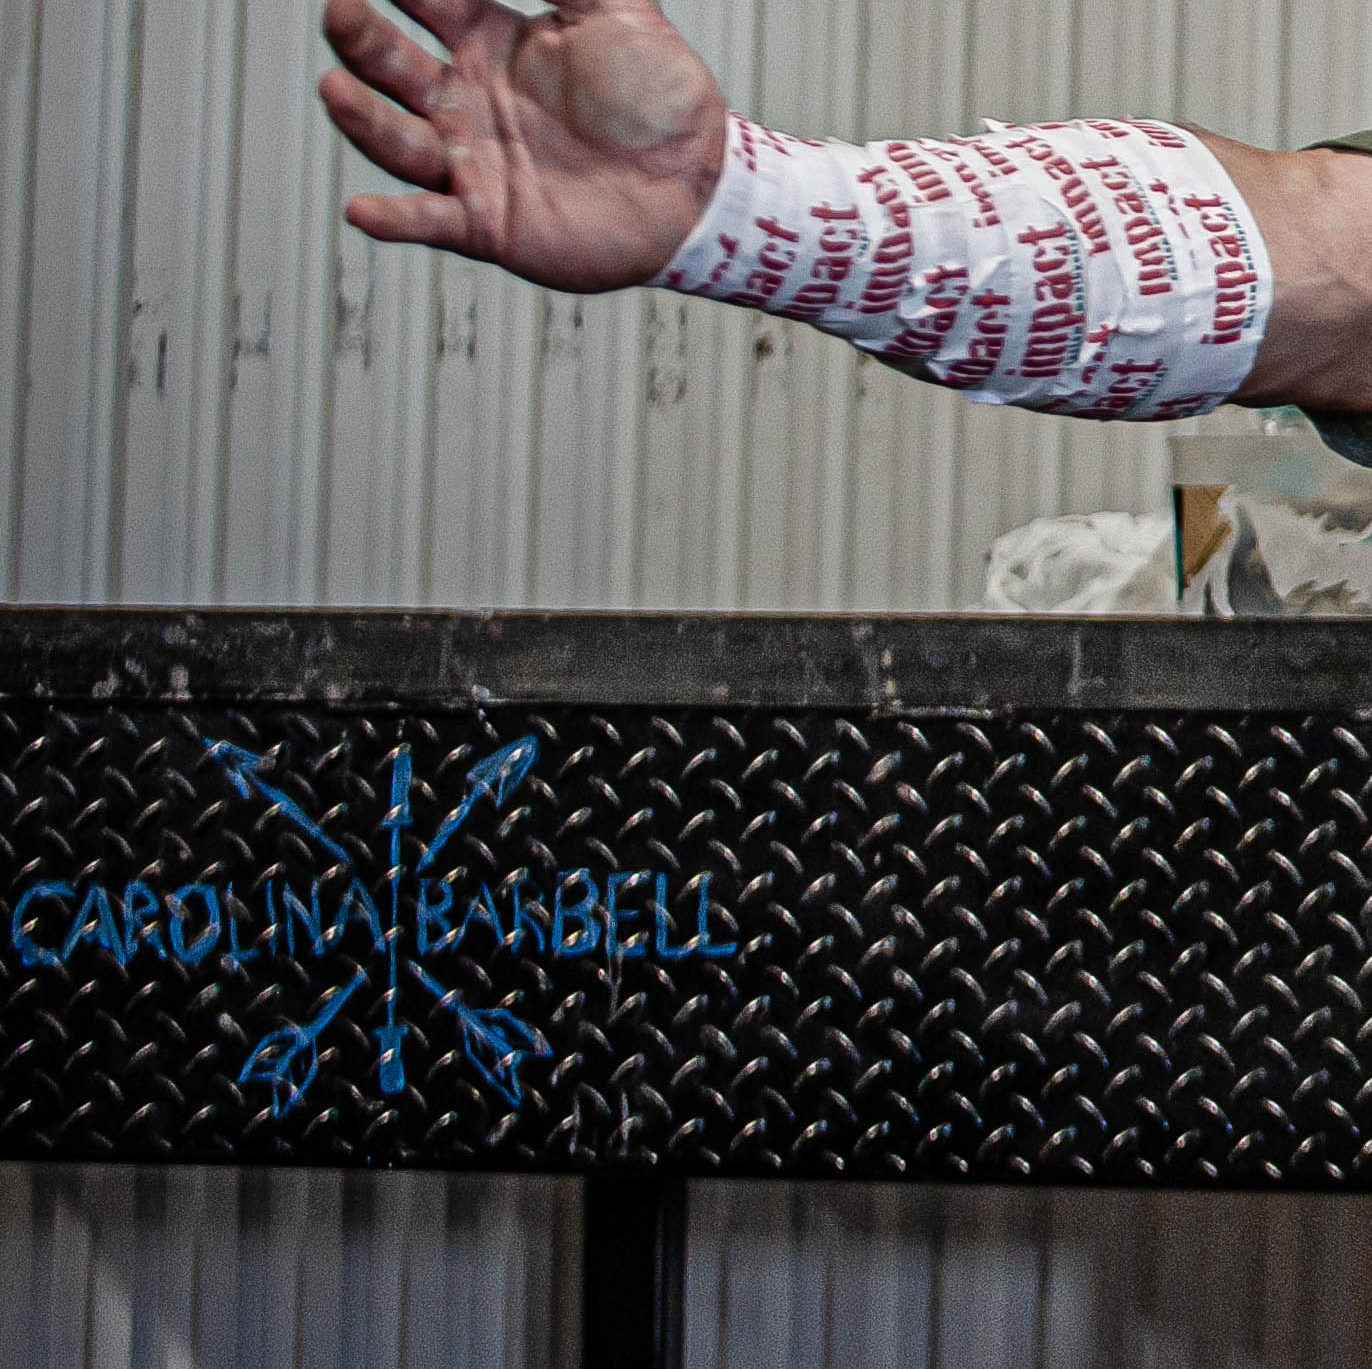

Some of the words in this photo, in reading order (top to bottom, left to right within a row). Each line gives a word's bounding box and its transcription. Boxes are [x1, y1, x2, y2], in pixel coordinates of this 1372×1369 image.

[1004, 221, 1086, 378] impact
[1184, 193, 1258, 344] impact
[11, 877, 388, 967] CAROLINA
[417, 868, 739, 961] BARBELL
